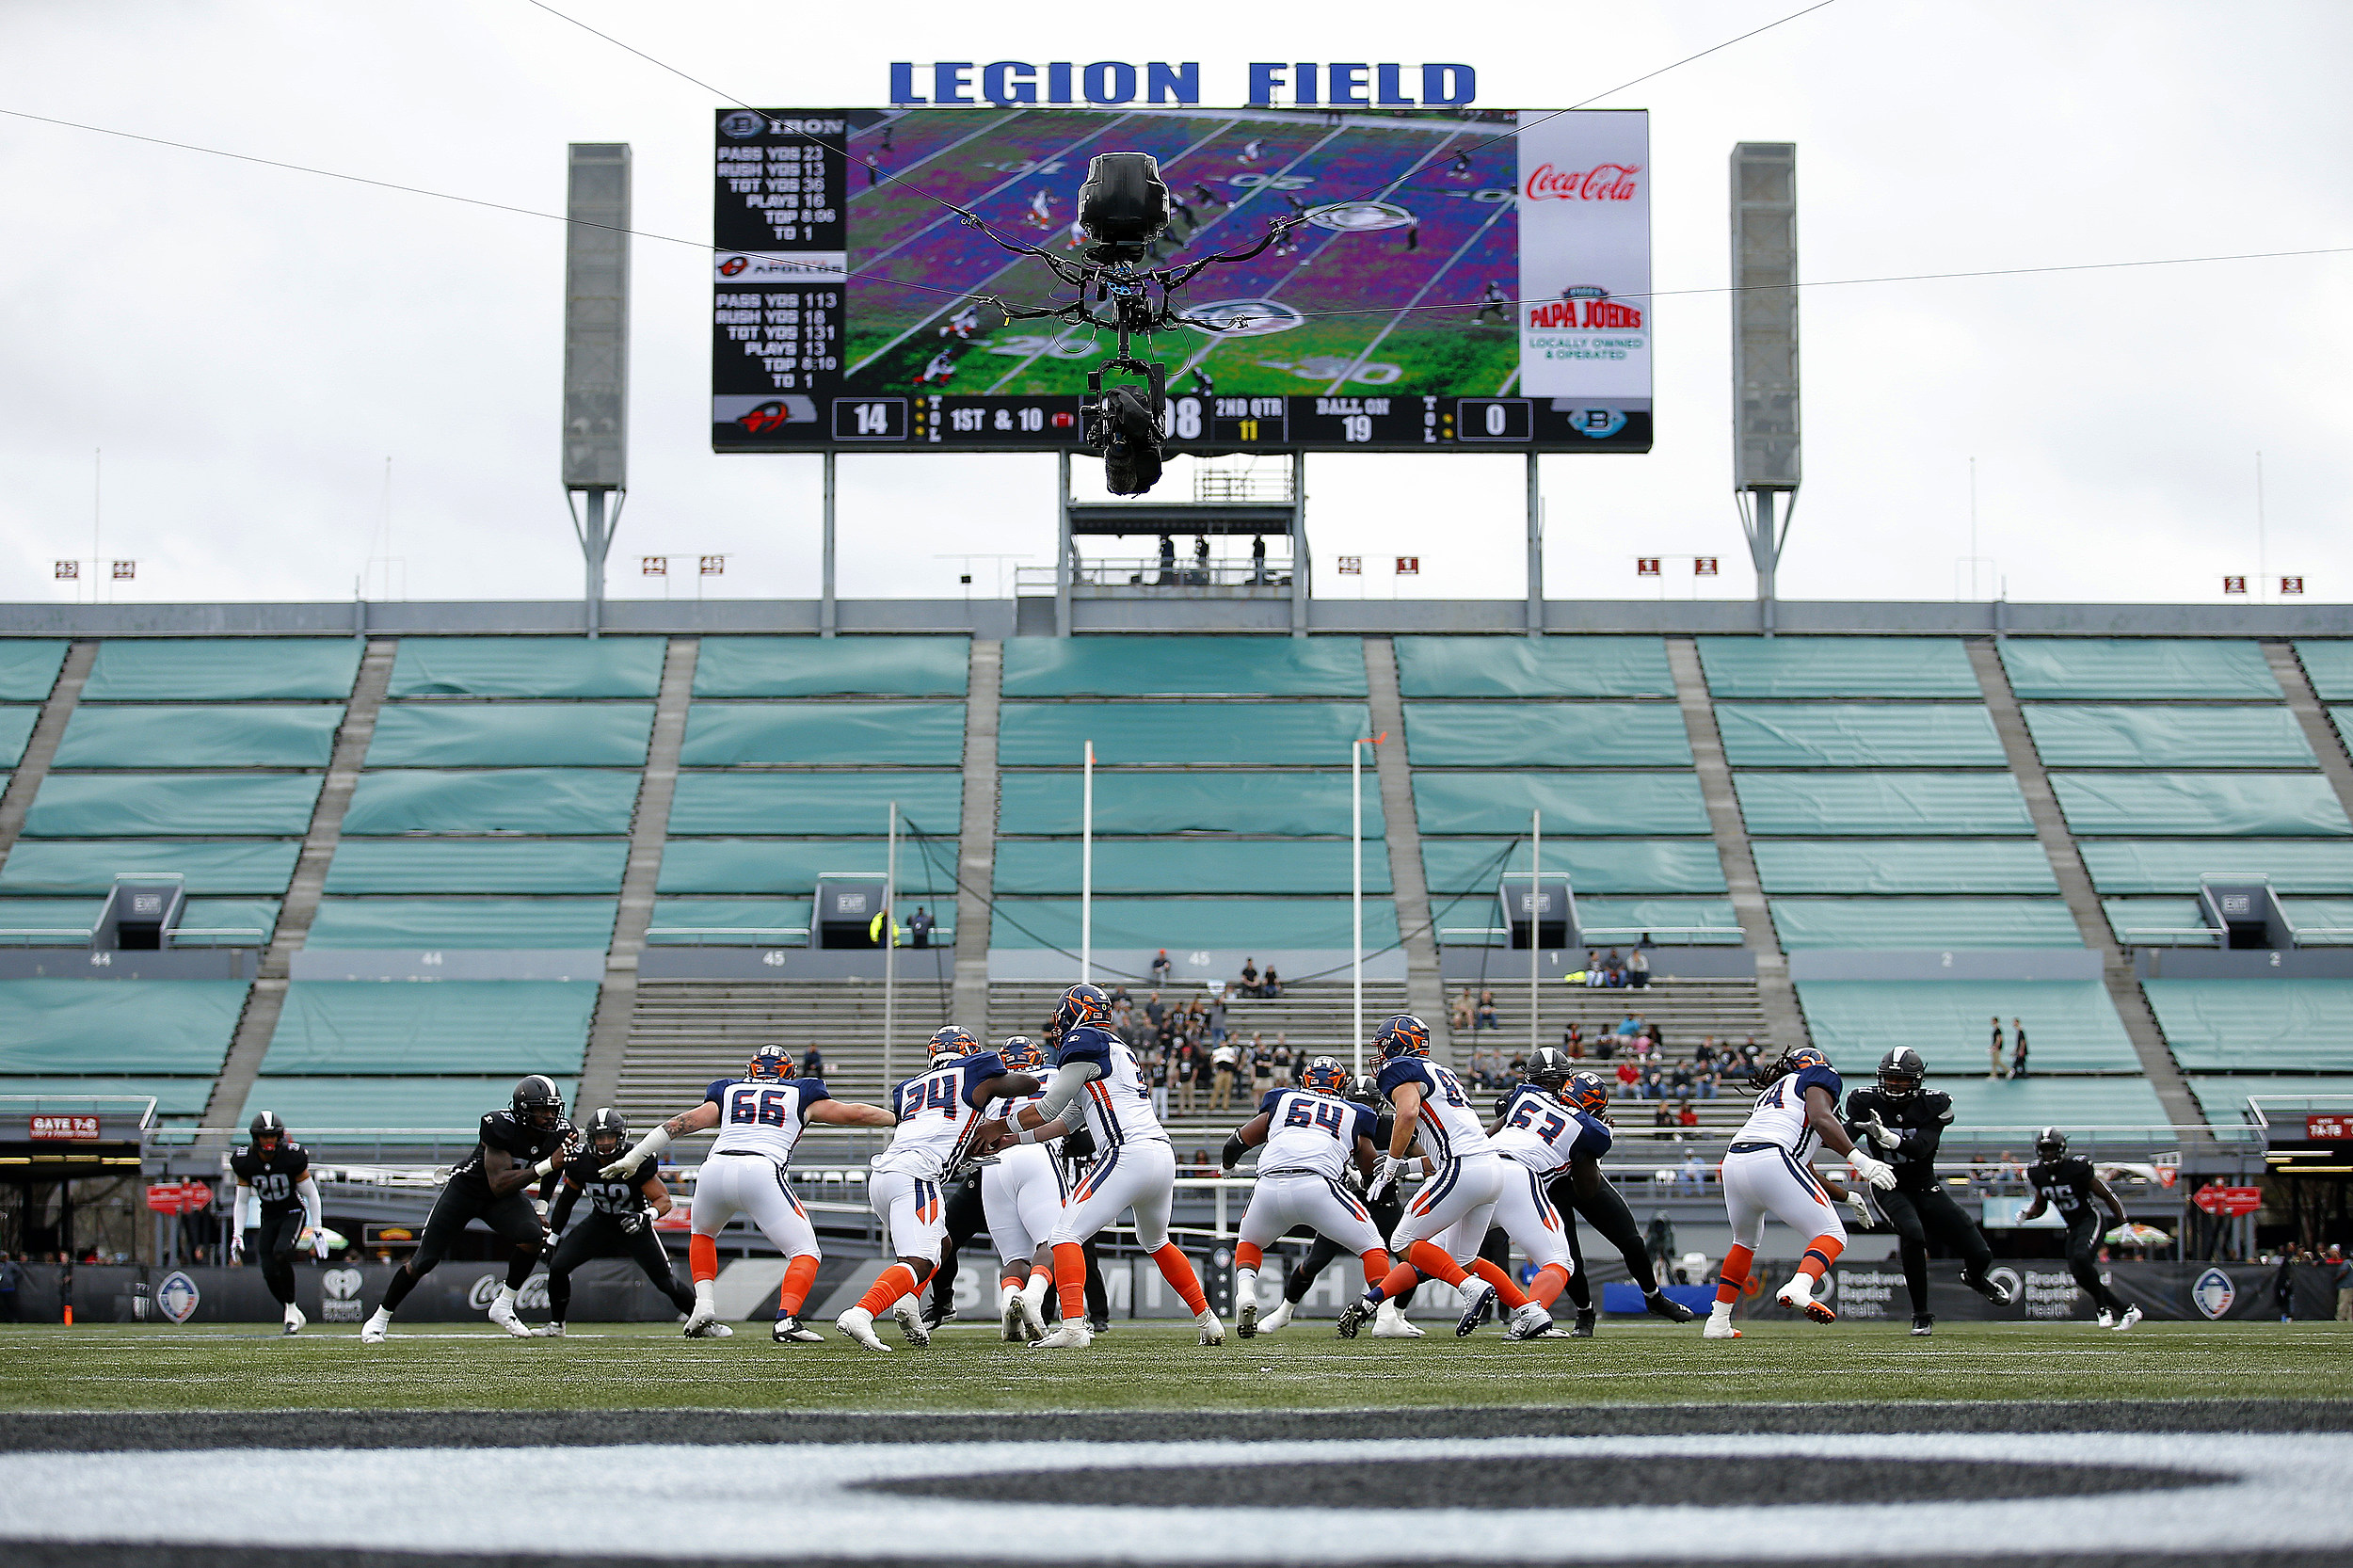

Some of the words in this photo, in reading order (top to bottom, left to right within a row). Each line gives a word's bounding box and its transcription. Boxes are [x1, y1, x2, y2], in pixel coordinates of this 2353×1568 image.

[890, 61, 1200, 105] LEGION
[1250, 61, 1476, 105] FIELD
[769, 119, 844, 135] IRON
[717, 146, 763, 161] PASS
[765, 146, 801, 161] YDS
[802, 145, 824, 161] 23
[717, 162, 763, 177] RUSH
[765, 162, 801, 177] YDS
[803, 161, 825, 177] 13
[728, 178, 762, 193] TOT
[765, 178, 800, 193] YDS
[802, 177, 825, 193] 36
[745, 193, 799, 208] PLAYS
[803, 193, 825, 208] 16
[763, 209, 798, 224] TOP
[772, 225, 796, 241] TO
[803, 225, 813, 241] 1
[715, 293, 761, 309] PASS
[764, 293, 800, 309] YDS
[804, 292, 837, 309] 113
[715, 310, 761, 324] RUSH
[764, 310, 799, 324] YDS
[804, 310, 826, 325] 18
[1530, 301, 1577, 328] PAPA
[727, 325, 760, 340] TOT
[763, 325, 798, 340] YDS
[804, 325, 835, 340] 131
[744, 341, 797, 356] PLAYS
[804, 341, 826, 356] 13
[1529, 338, 1588, 348] LOCALLY
[1592, 338, 1643, 348] OWNED
[1556, 349, 1627, 360] OPERATED
[762, 357, 796, 372] TOP
[772, 373, 795, 388] TO
[804, 372, 813, 389] 1
[1215, 398, 1248, 417] 2ND
[1250, 398, 1282, 418] QTR
[1316, 398, 1363, 415] BALL
[1365, 398, 1390, 415] ON
[854, 403, 888, 434] 14
[950, 408, 985, 431] 1ST
[994, 408, 1014, 431] &
[1021, 407, 1044, 431] 10
[1485, 404, 1506, 436] 0
[1239, 419, 1258, 441] 11
[1341, 415, 1372, 442] 19
[91, 952, 111, 967] 44
[422, 951, 442, 966] 44
[762, 951, 785, 967] 45
[1189, 951, 1210, 967] 45
[1551, 951, 1559, 966] 1
[1942, 952, 1953, 967] 2
[2269, 952, 2281, 967] 2
[760, 1046, 780, 1056] 66
[903, 1074, 957, 1121] 24
[730, 1090, 787, 1128] 66
[33, 1117, 72, 1129] GATE
[1284, 1097, 1344, 1141] 64
[251, 1174, 290, 1202] 20
[585, 1182, 634, 1215] 52
[1837, 1270, 1905, 1287] Brookwo
[1837, 1285, 1892, 1304] Baptist
[2025, 1286, 2078, 1304] Baptist
